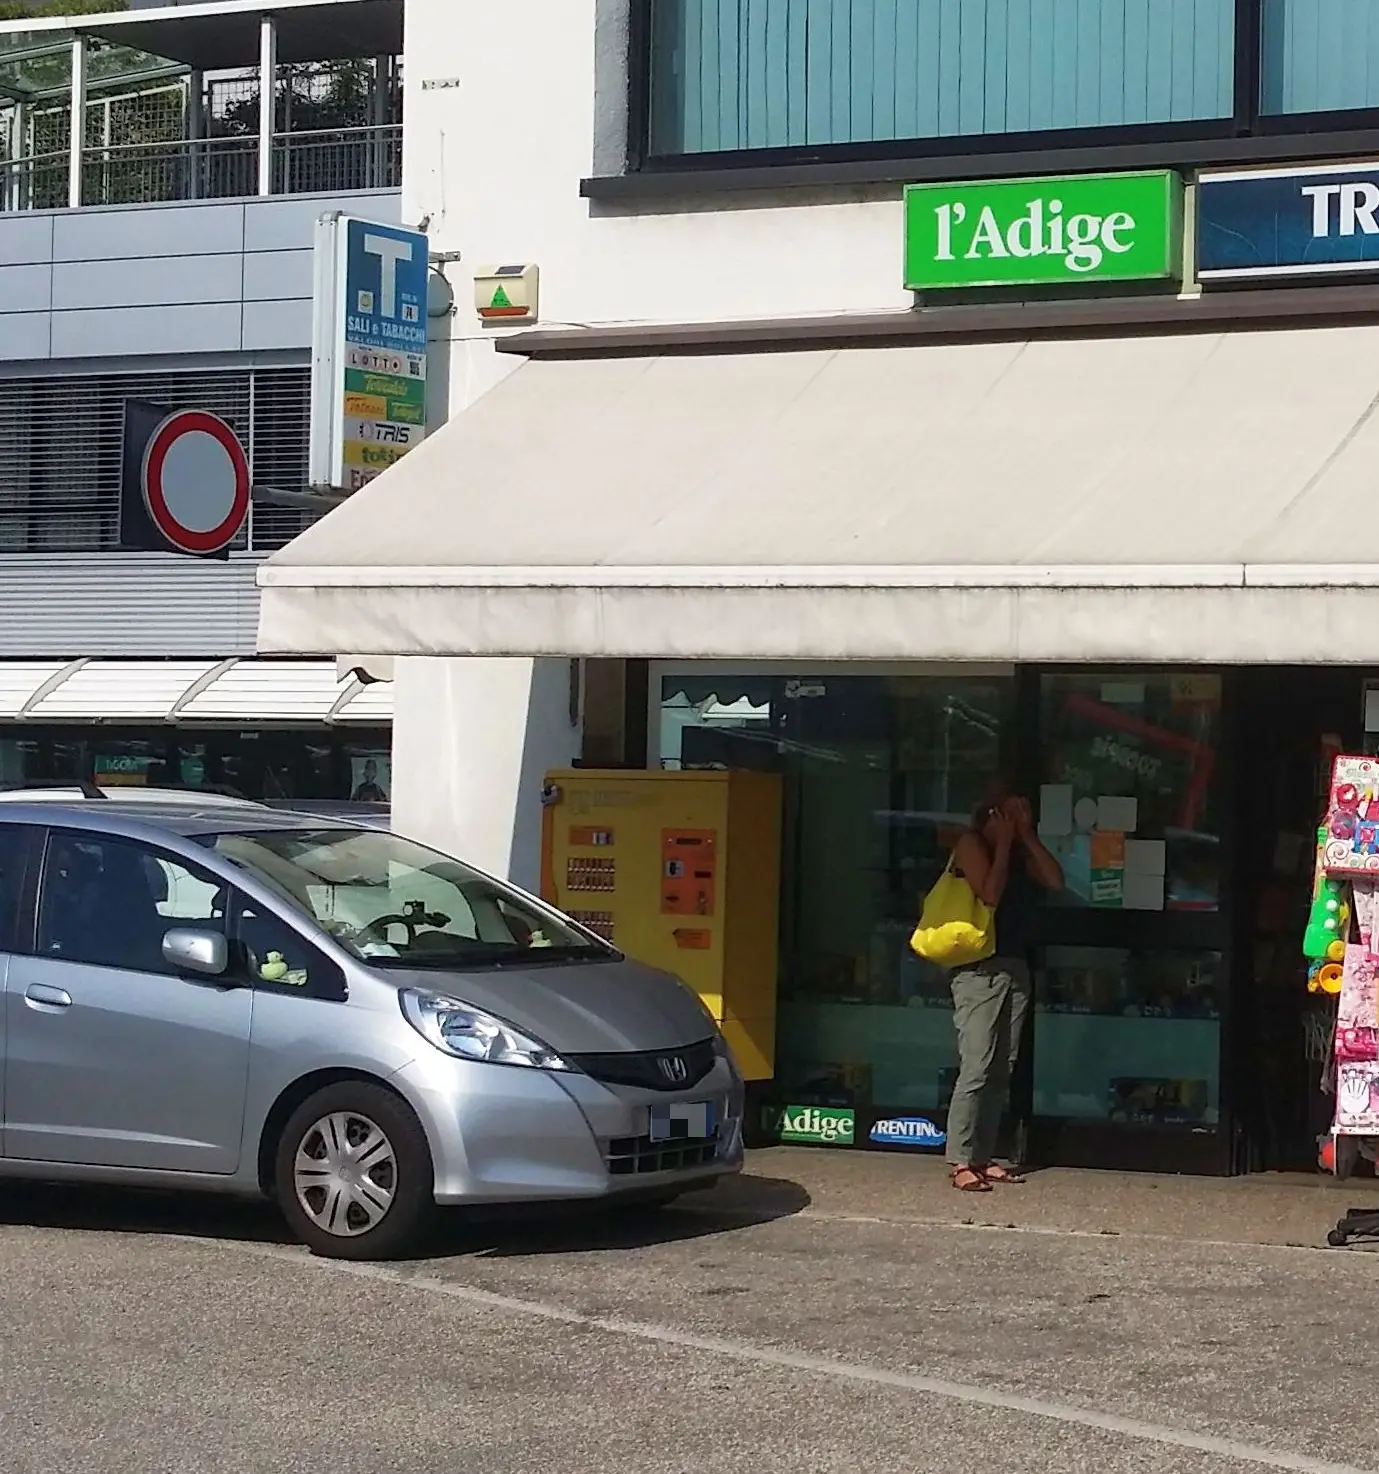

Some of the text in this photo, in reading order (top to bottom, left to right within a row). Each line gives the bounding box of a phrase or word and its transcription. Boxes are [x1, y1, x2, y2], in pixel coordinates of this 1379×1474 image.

[934, 197, 1136, 272] l'Adige
[364, 233, 412, 318] T
[347, 315, 425, 343] SALI e TABACCHI
[376, 423, 411, 444] TRIS
